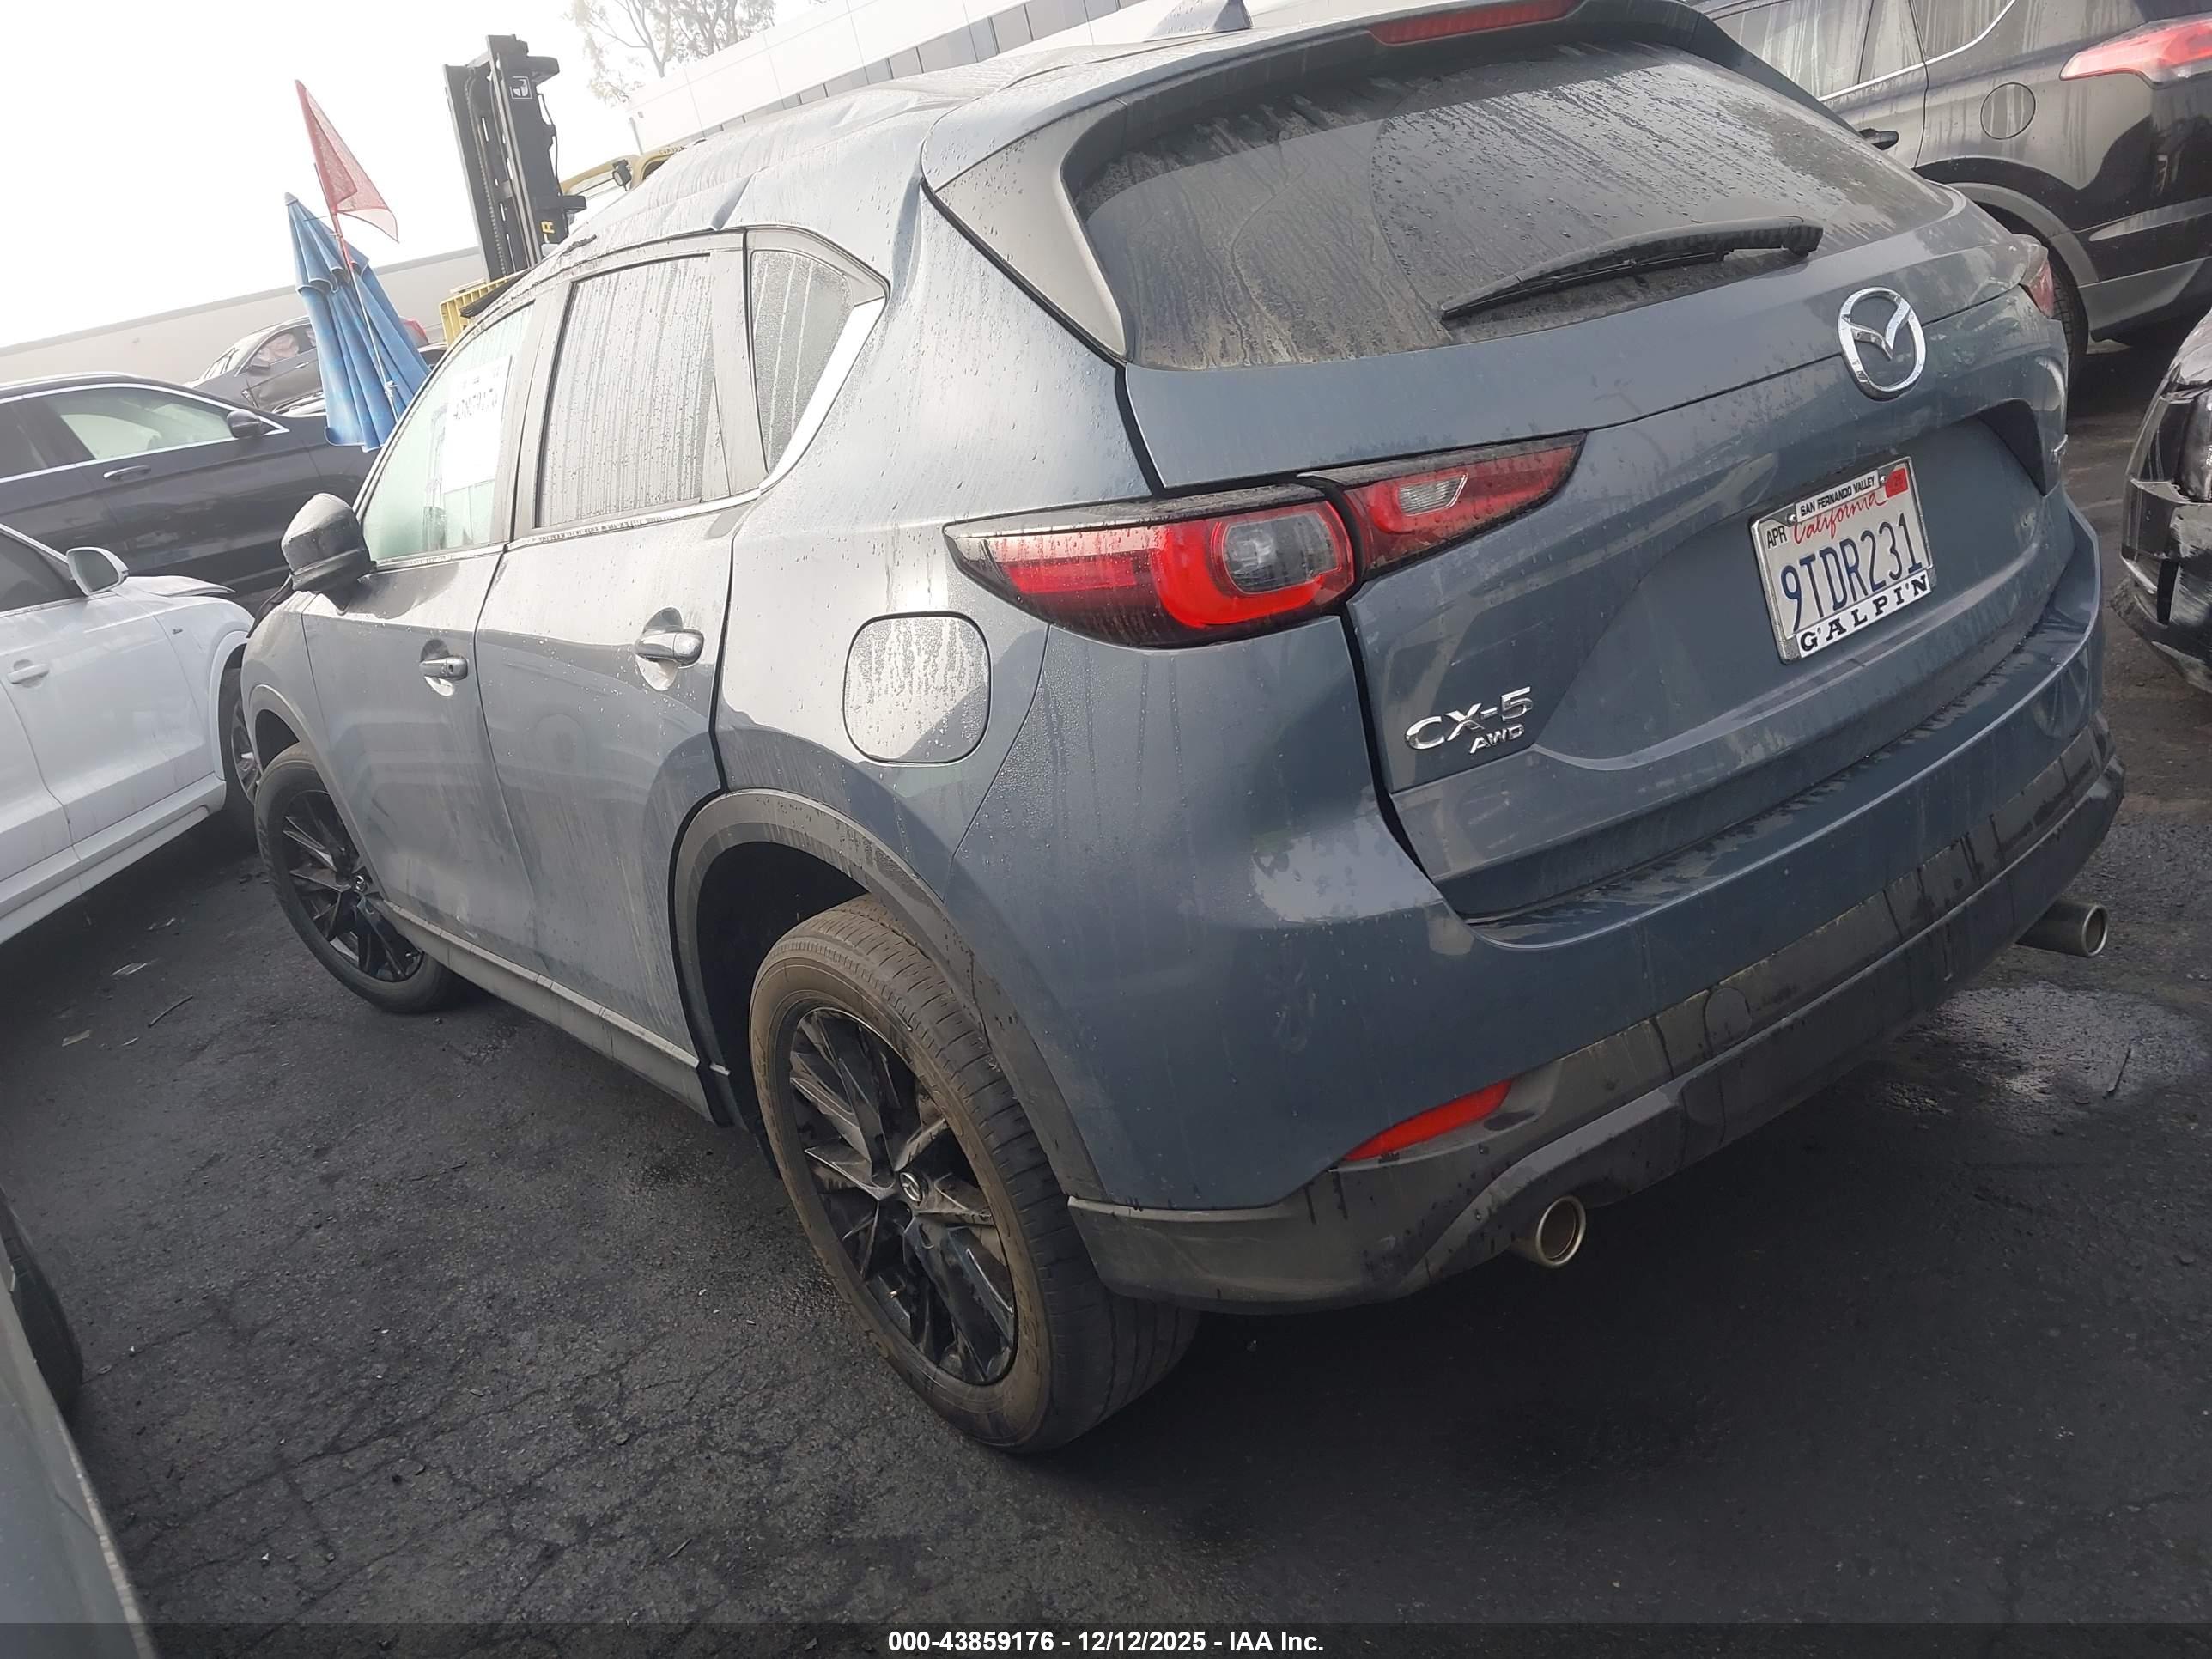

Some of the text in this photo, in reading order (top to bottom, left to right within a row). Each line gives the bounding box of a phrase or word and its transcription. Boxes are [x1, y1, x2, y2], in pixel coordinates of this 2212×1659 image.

[1793, 494, 1888, 544] California
[1800, 475, 1875, 517] SAN FERNANDO VALLEY
[1766, 526, 1788, 549] APR
[1780, 513, 1923, 631] 9TDR231
[1405, 684, 1534, 750] CX-5
[1468, 723, 1525, 754] AWD
